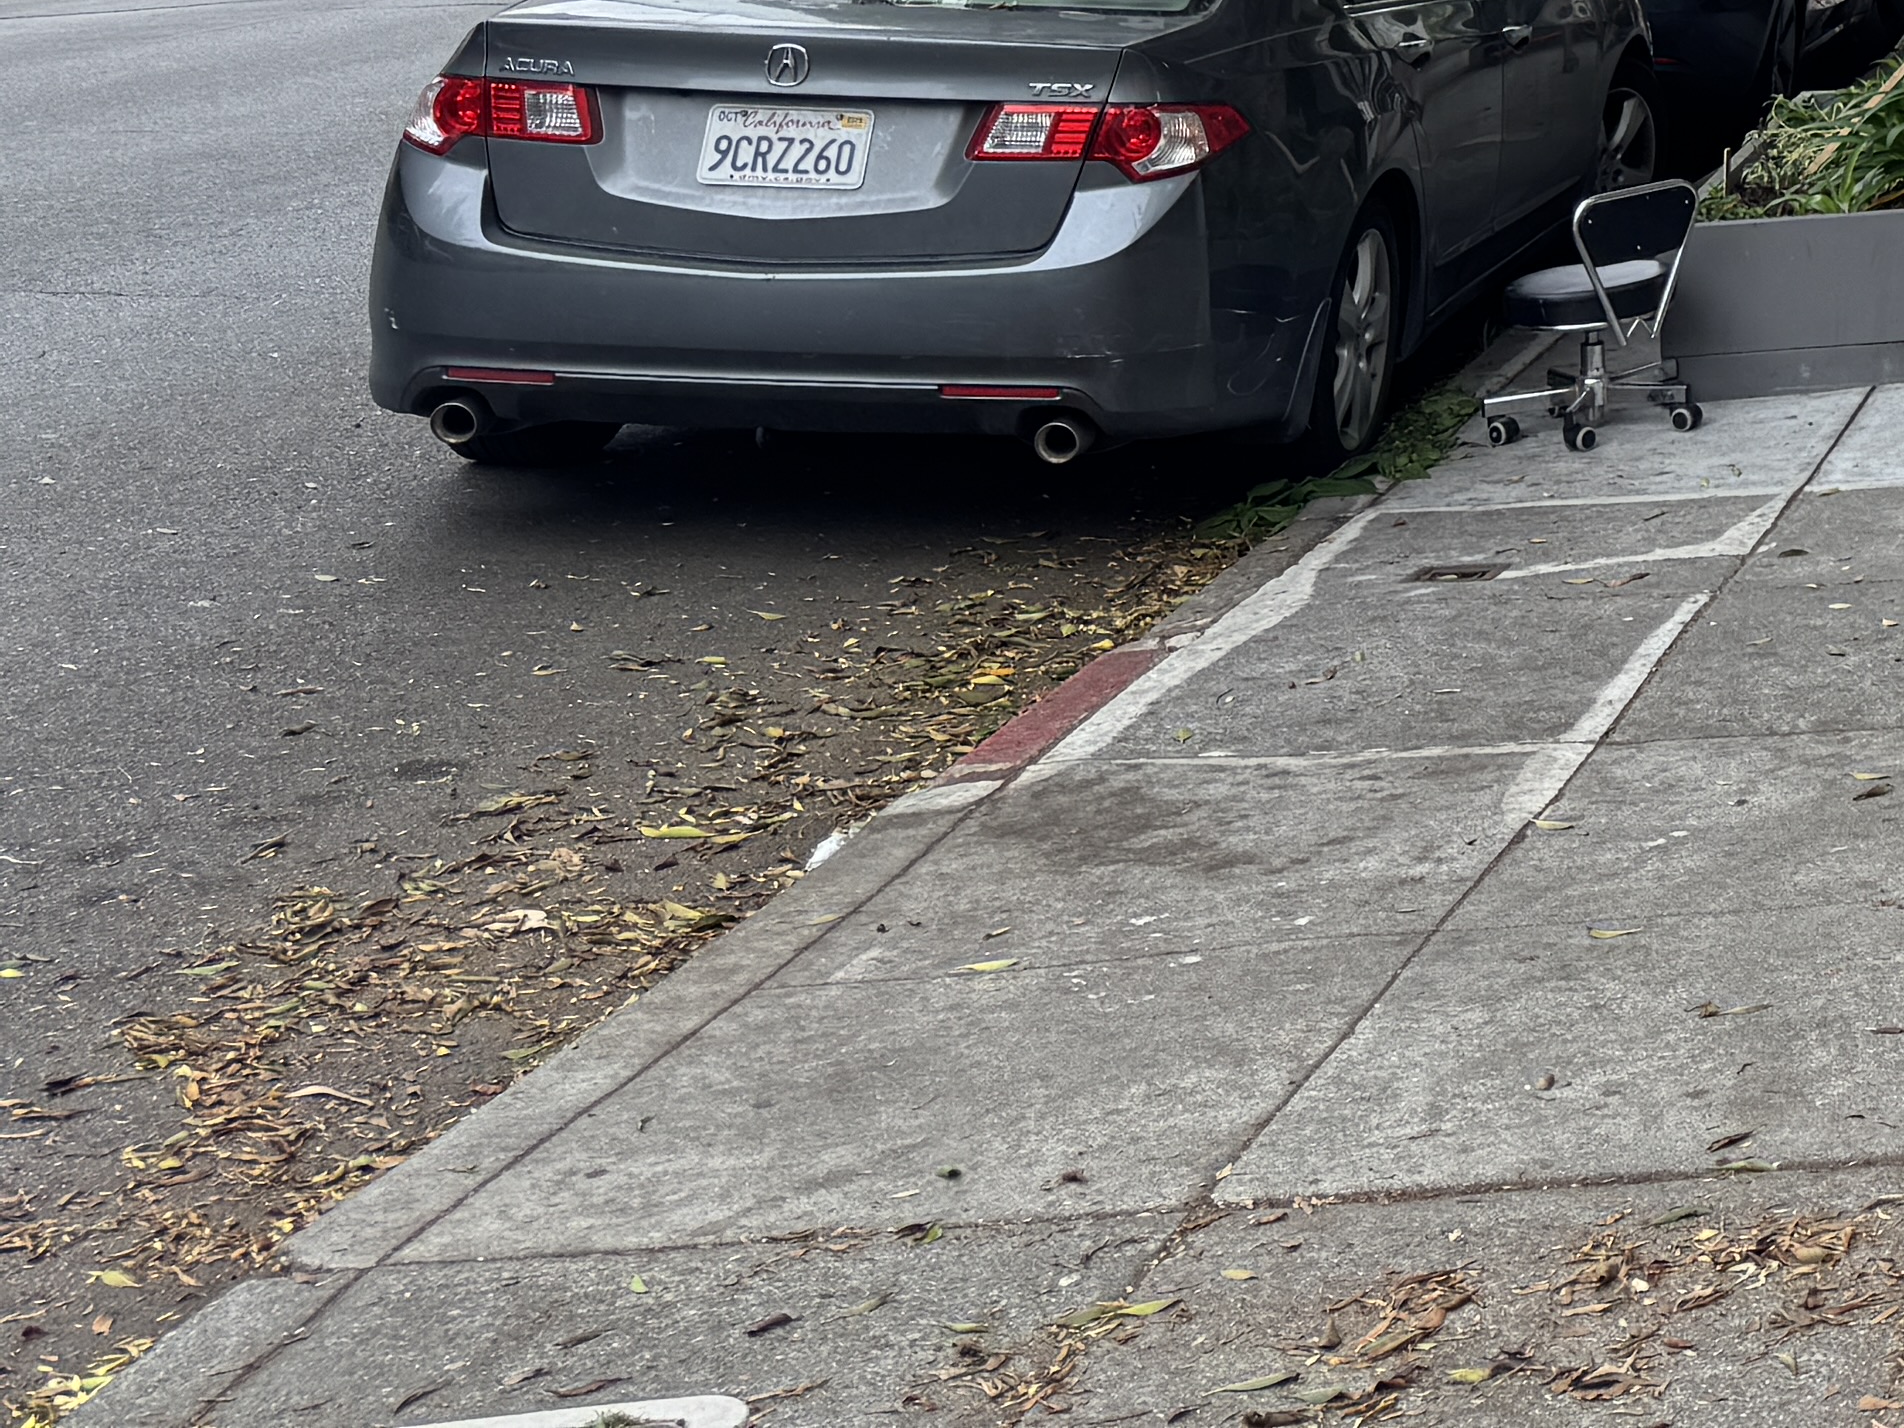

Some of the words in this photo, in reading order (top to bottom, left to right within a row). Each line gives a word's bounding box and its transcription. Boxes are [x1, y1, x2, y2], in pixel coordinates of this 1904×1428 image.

[500, 56, 575, 76] ACURA
[1028, 82, 1094, 98] TSX
[718, 110, 738, 123] OCT
[743, 110, 841, 135] California
[708, 134, 856, 176] 9CRZ260
